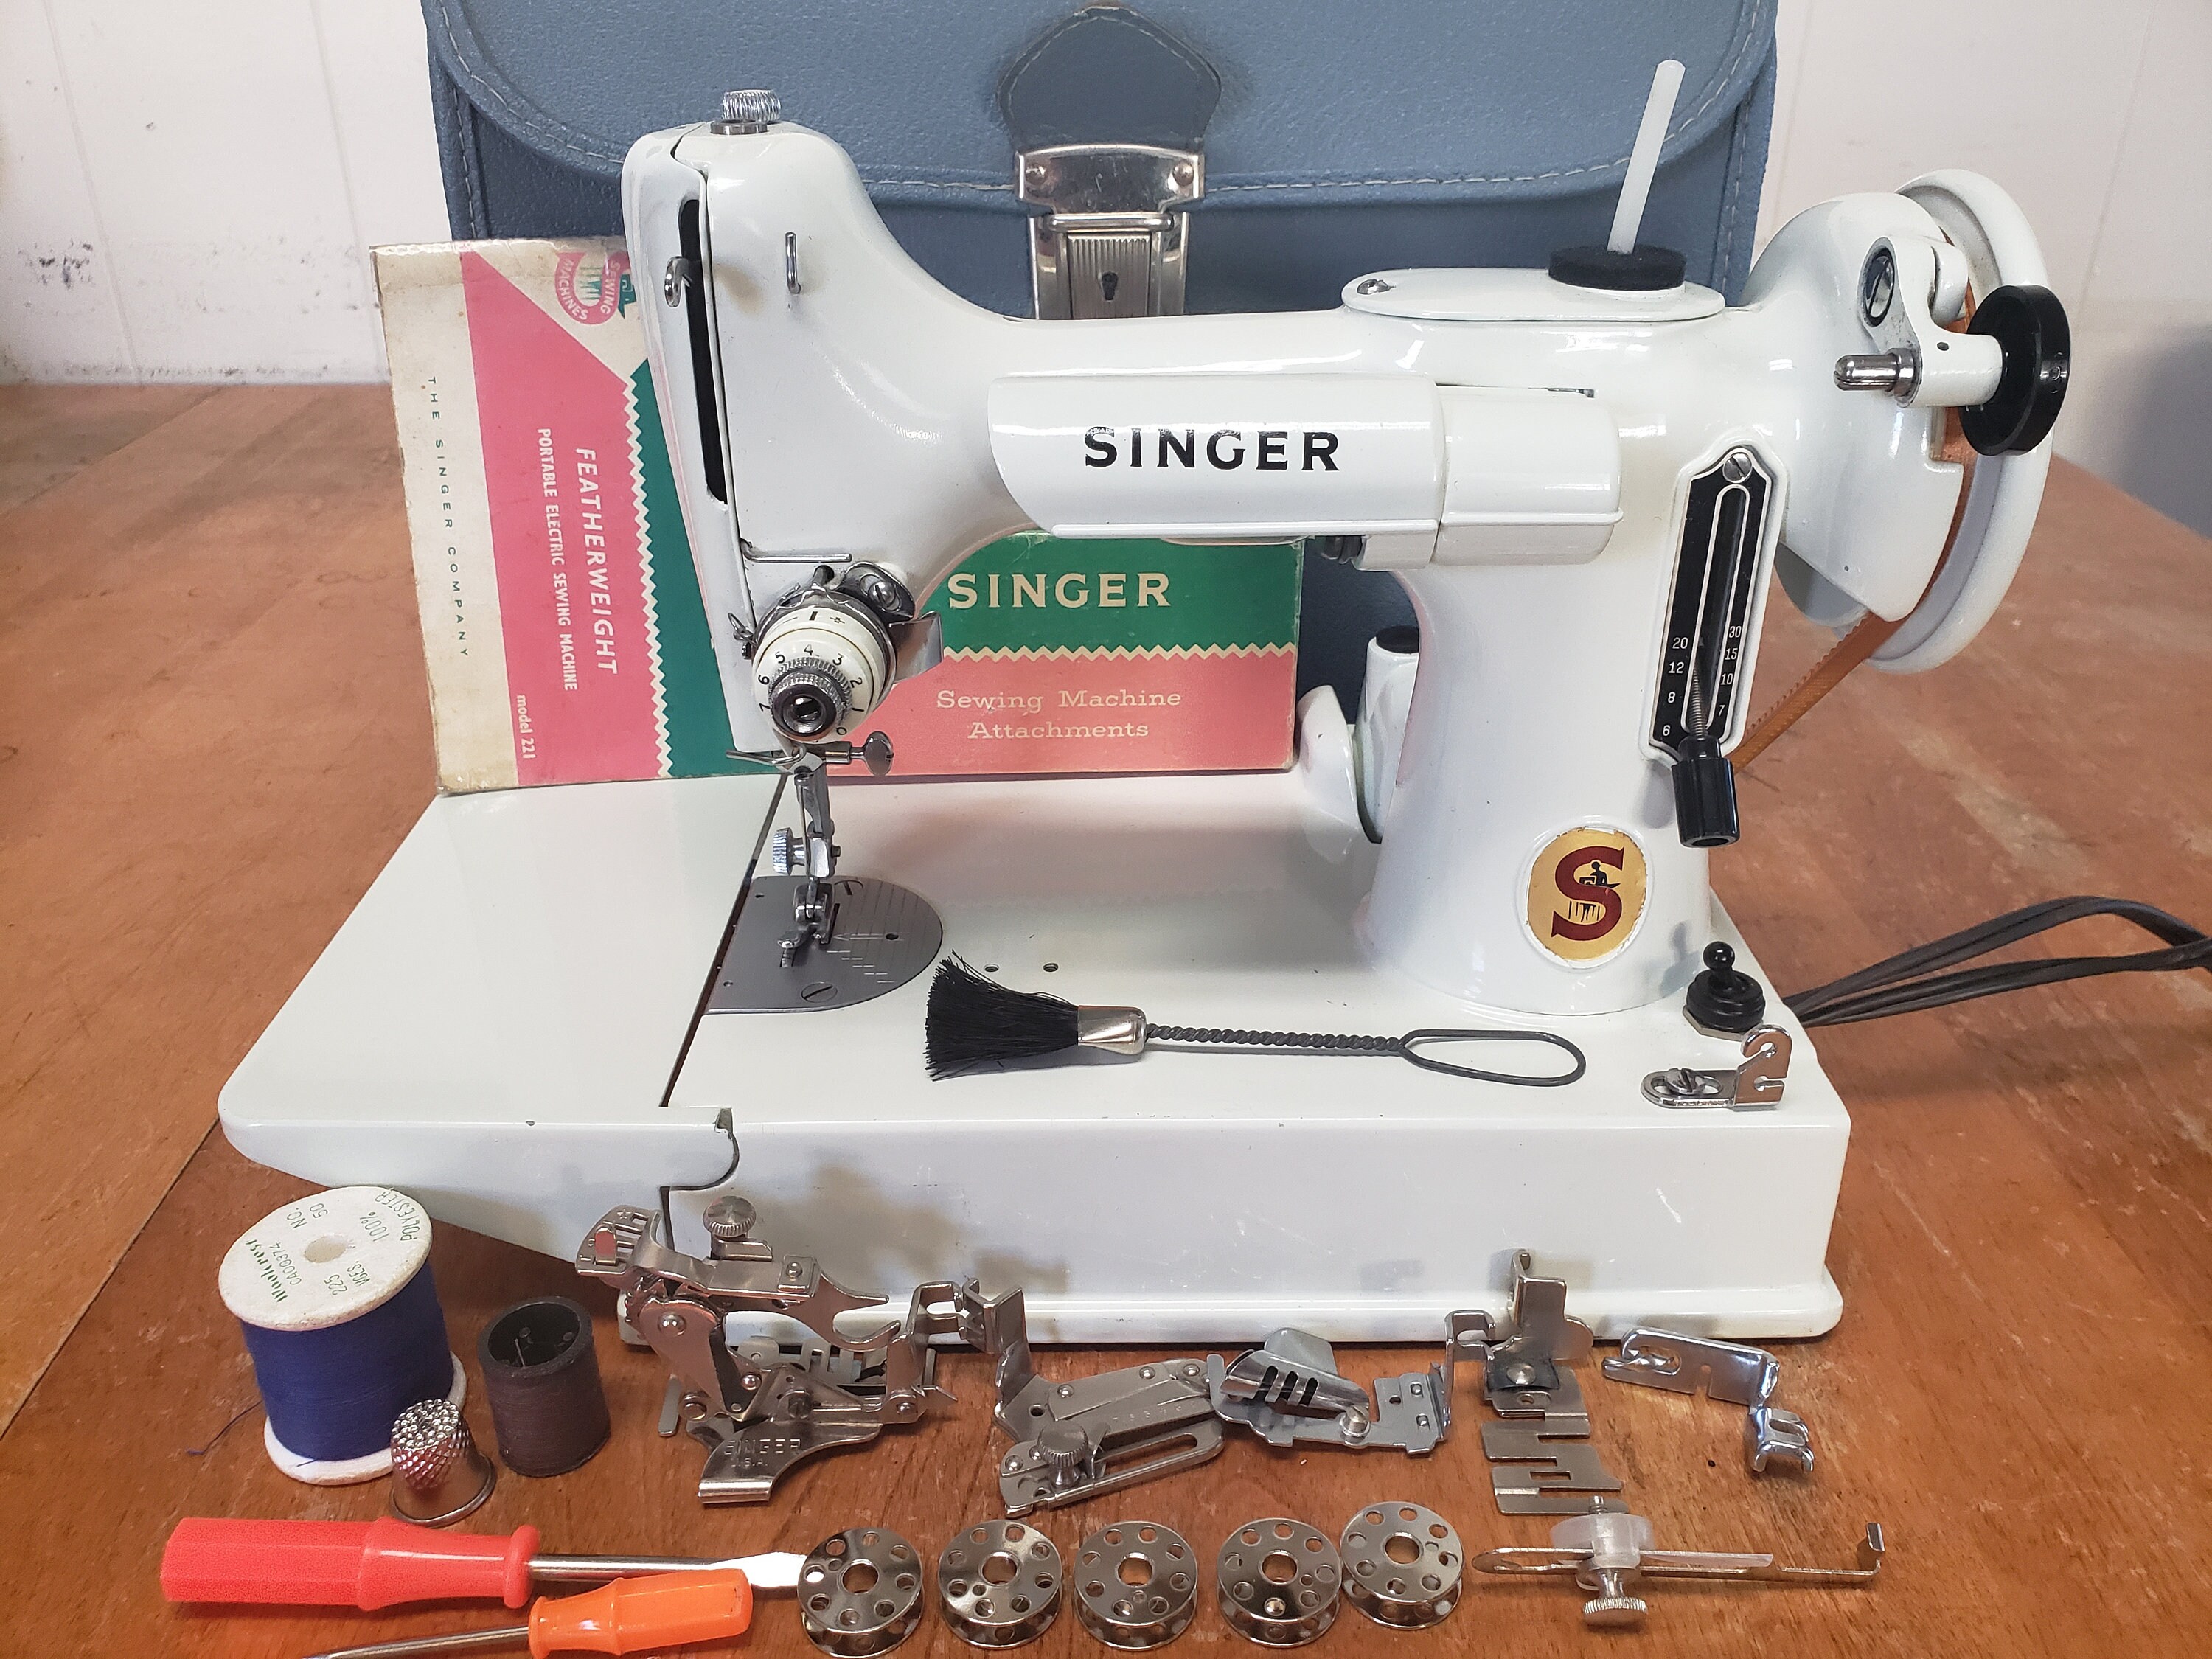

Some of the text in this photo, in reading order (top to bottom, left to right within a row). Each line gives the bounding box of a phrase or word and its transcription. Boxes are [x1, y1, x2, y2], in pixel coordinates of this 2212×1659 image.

[558, 259, 588, 320] MACHINES
[600, 260, 620, 314] SEWING
[1085, 426, 1340, 471] SINGER
[428, 376, 468, 657] THE SINGER COMPANY
[538, 428, 578, 691] PORTABLE ELECTRIC SEWING MACHINE
[576, 448, 617, 675] FEATHERWEIGHT
[947, 573, 1171, 609] SINGER
[1728, 625, 1742, 638] 30
[803, 644, 813, 655] 4
[1672, 637, 1688, 649] 20
[774, 651, 786, 664] 5
[832, 653, 843, 665] 3
[1725, 648, 1738, 660] 15
[1669, 661, 1684, 674] 12
[757, 674, 770, 685] 6
[849, 676, 863, 689] 2
[1720, 673, 1733, 685] 10
[936, 689, 1181, 712] Sewing Machine
[1667, 691, 1676, 703] 8
[759, 703, 771, 712] 7
[1718, 704, 1725, 717] 7
[517, 695, 536, 759] model 221
[967, 722, 1149, 739] Attachments
[1662, 724, 1671, 736] 6
[309, 1203, 328, 1219] 50
[375, 1191, 421, 1242] POLYESTER
[360, 1211, 390, 1242] 100%
[324, 1274, 348, 1295] 225
